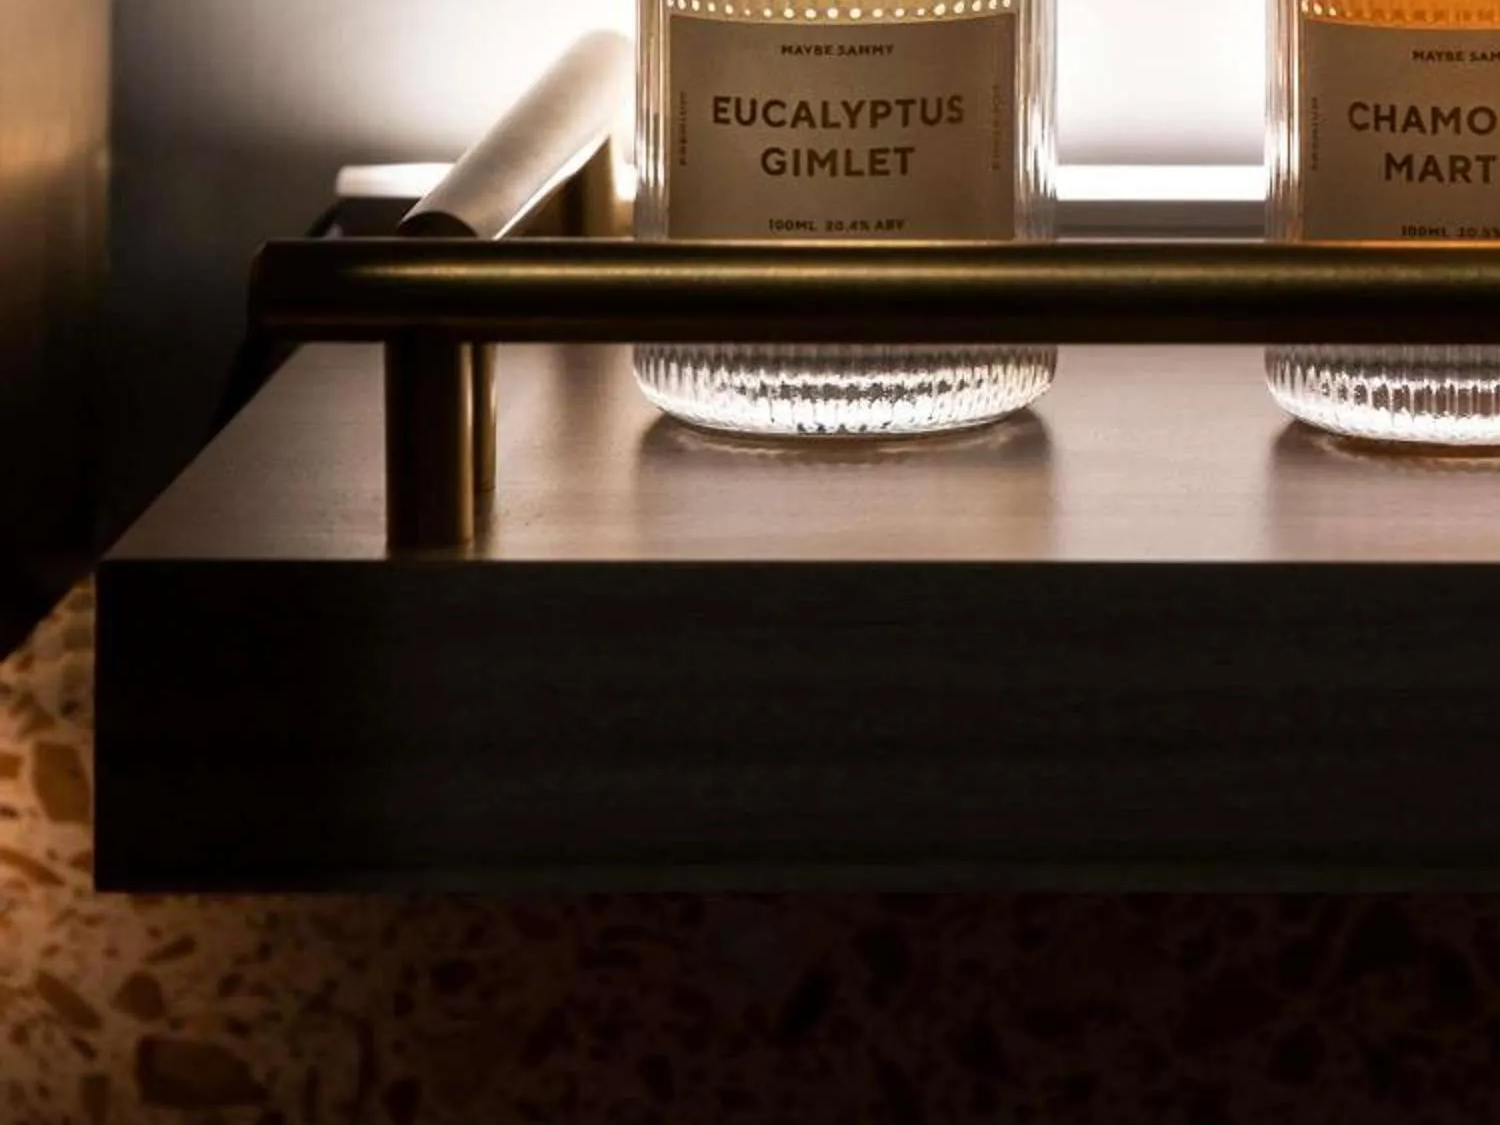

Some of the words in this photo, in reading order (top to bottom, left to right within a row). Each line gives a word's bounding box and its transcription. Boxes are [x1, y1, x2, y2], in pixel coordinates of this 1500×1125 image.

[781, 44, 833, 57] MAYBE
[837, 44, 895, 57] SAMMY
[1412, 50, 1465, 62] MAYBE
[712, 95, 965, 129] EUCALYPTUS
[760, 146, 916, 178] GIMLET
